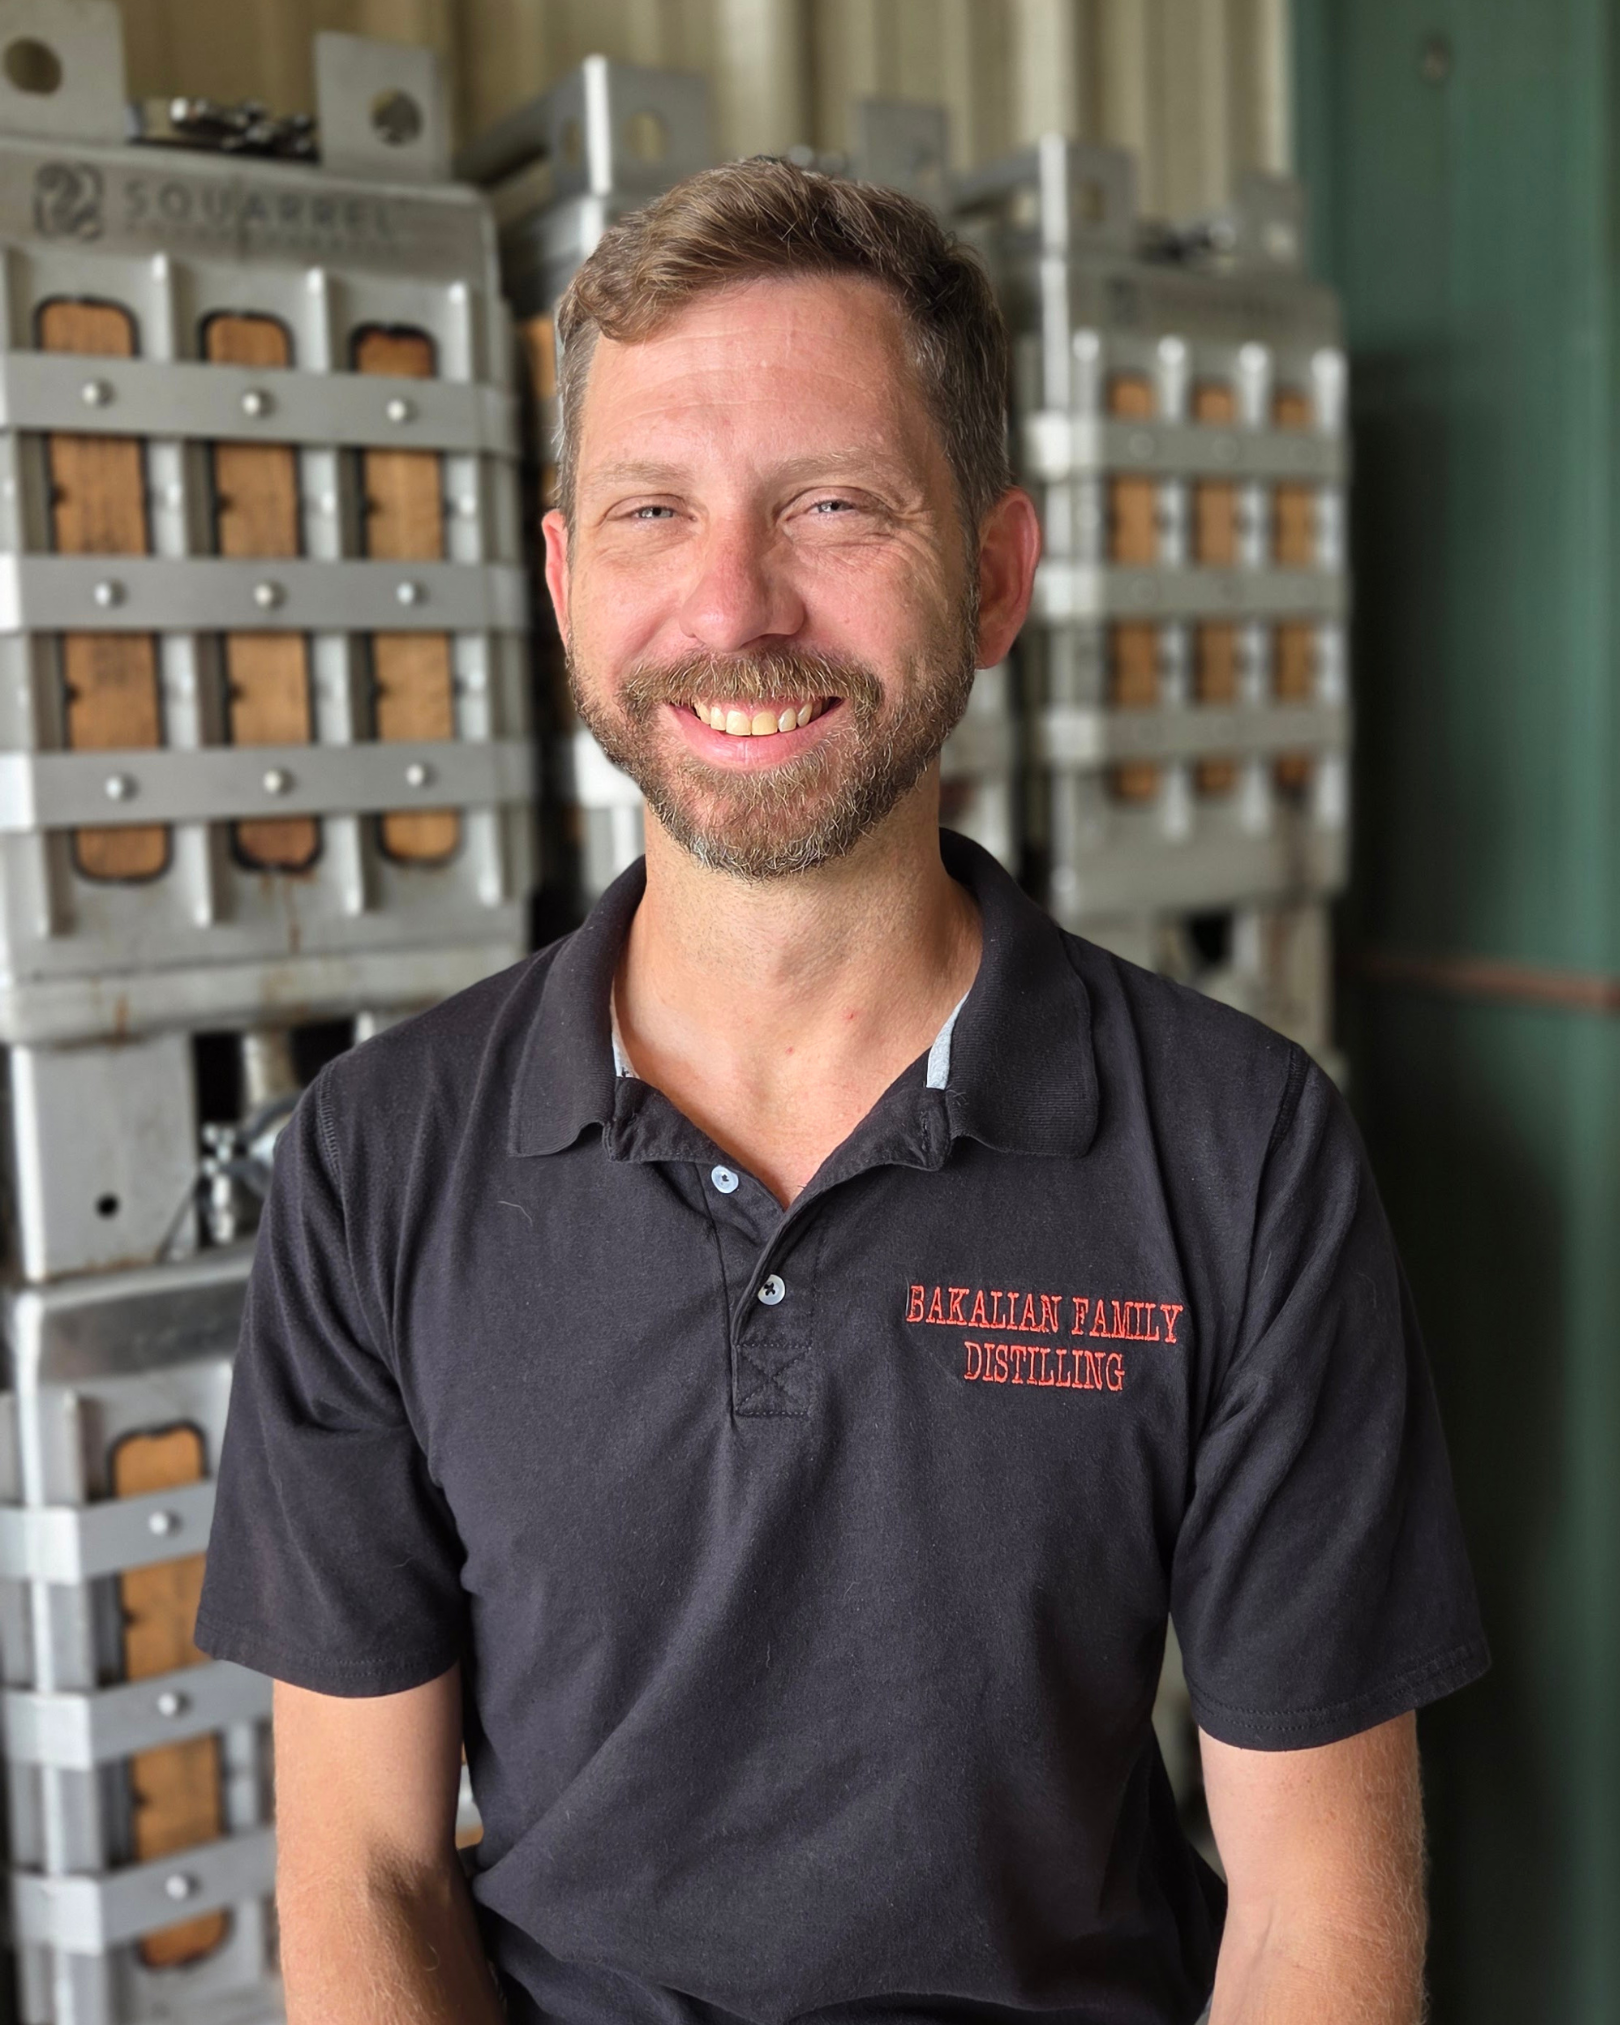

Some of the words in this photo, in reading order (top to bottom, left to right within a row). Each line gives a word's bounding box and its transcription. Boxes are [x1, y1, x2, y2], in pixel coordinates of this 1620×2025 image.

[124, 180, 398, 233] SQUARREL
[906, 1284, 1062, 1333] BAKALIAN
[1071, 1296, 1183, 1343] FAMILY
[964, 1340, 1125, 1391] DISTILLING
